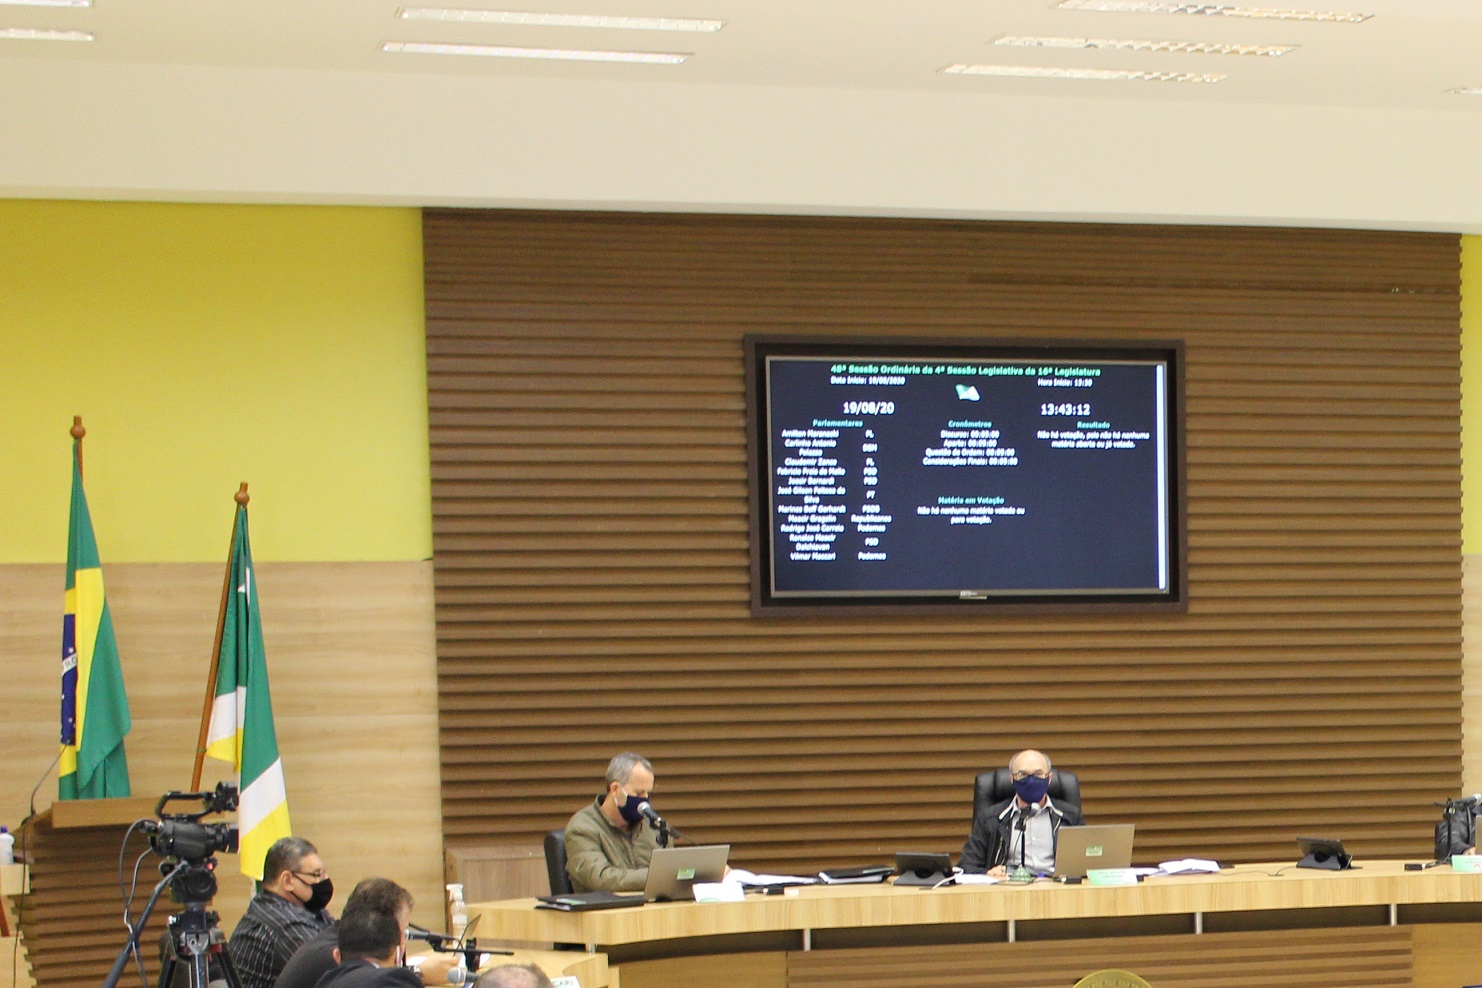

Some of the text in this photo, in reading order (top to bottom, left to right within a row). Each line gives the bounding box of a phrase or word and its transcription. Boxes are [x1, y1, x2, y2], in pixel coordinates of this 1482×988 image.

[848, 364, 879, 374] Sessão
[881, 365, 920, 375] Ordinária
[922, 366, 933, 375] da
[947, 365, 977, 375] Sessão
[978, 366, 1023, 376] Legislativa
[1025, 366, 1036, 375] da
[1054, 367, 1101, 377] Legislatura
[843, 401, 895, 415] 19/08/20
[1041, 403, 1090, 416] 13:43:12
[812, 419, 864, 428] Parlamentares
[948, 420, 992, 429] Cronômetros
[1077, 421, 1110, 429] Resultado
[938, 497, 964, 505] Matéria
[977, 497, 1004, 505] Votação
